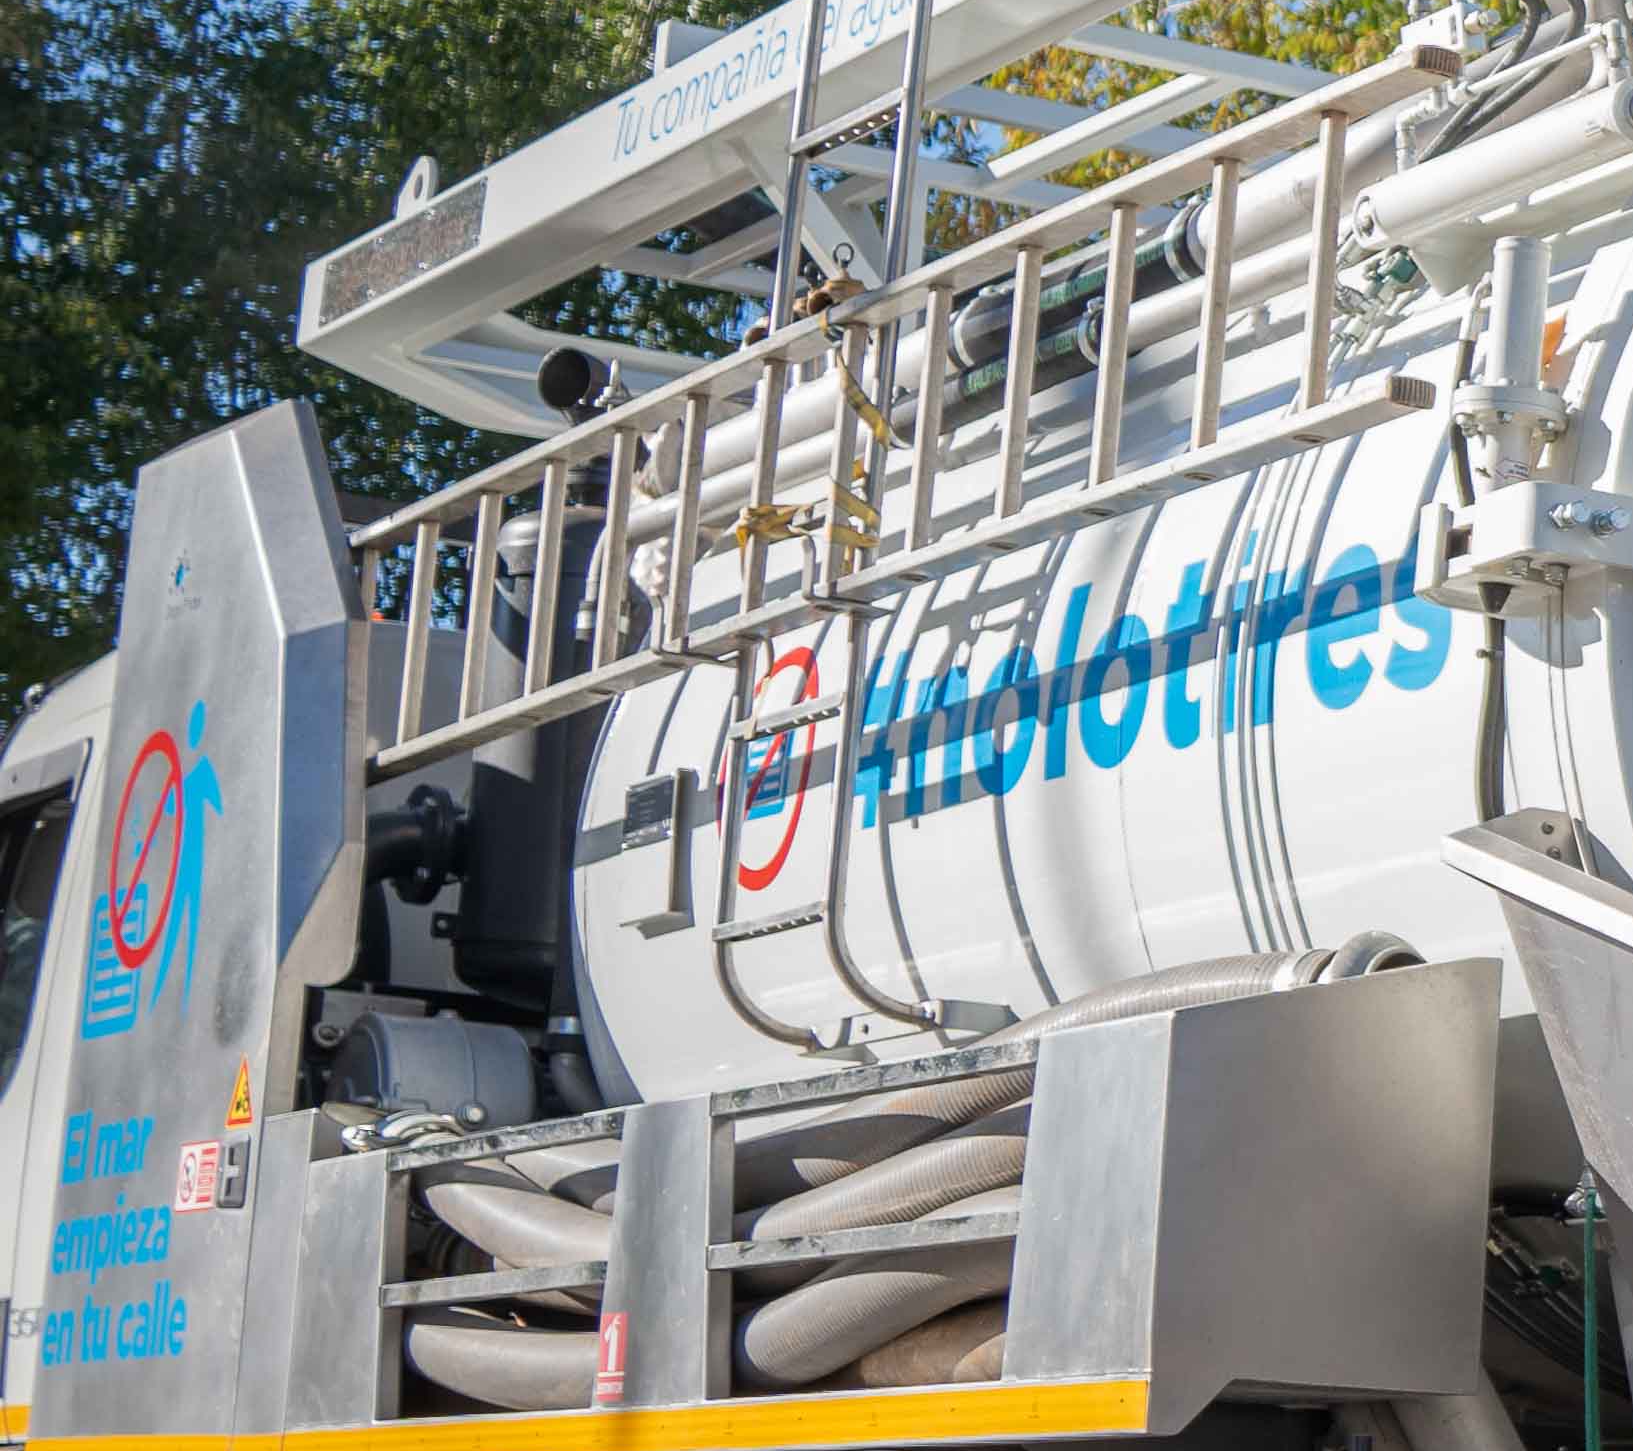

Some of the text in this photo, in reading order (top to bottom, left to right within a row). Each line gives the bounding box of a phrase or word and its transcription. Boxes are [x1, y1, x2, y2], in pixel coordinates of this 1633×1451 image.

[613, 97, 644, 162] Tu
[650, 17, 788, 141] compañía
[61, 1108, 93, 1185] El
[93, 1115, 155, 1179] mar
[51, 1193, 171, 1286] empieza
[41, 1309, 76, 1368] en
[81, 1292, 111, 1363] tu
[116, 1279, 187, 1359] calle
